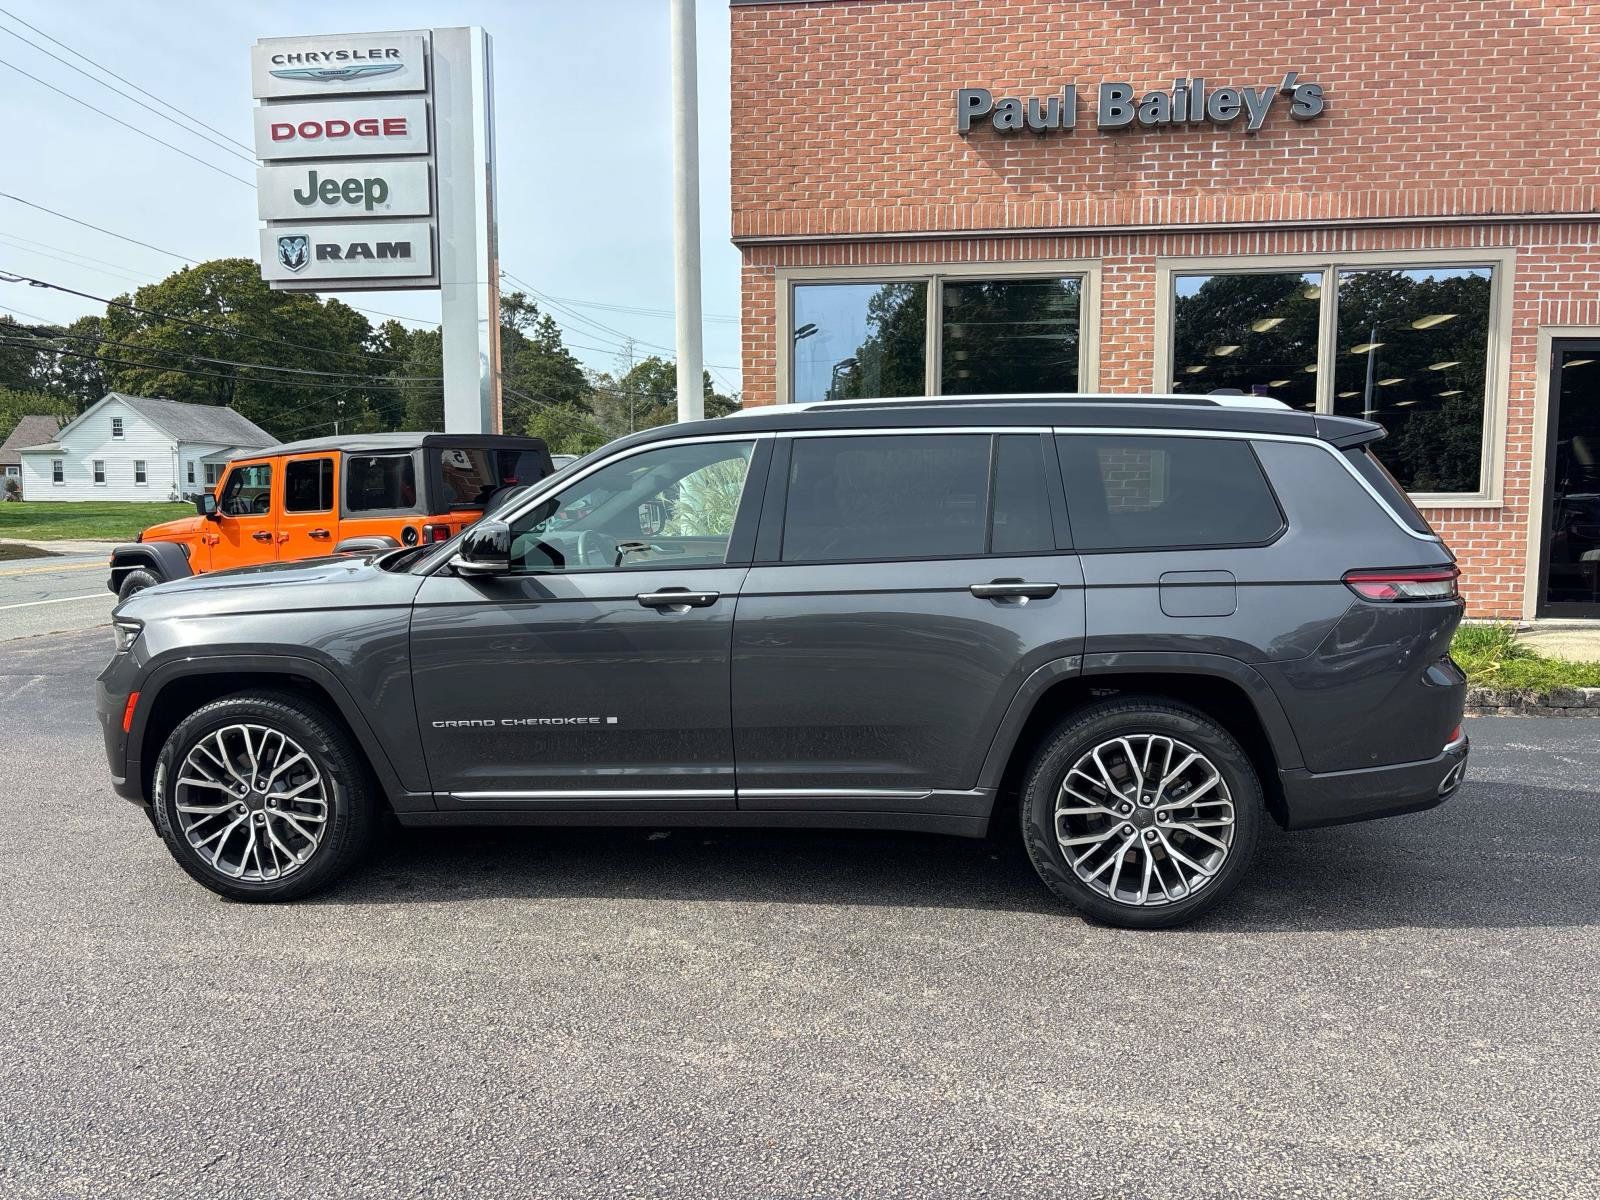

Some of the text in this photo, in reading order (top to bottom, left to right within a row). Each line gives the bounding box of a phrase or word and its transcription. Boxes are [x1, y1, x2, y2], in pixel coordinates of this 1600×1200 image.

[271, 48, 400, 65] CHRYSLER
[957, 72, 1324, 134] Paul Bailey's
[271, 118, 408, 141] DODGE
[293, 170, 389, 211] Jeep
[315, 241, 411, 261] RAM
[432, 717, 601, 728] GRAND CHEROKEE
